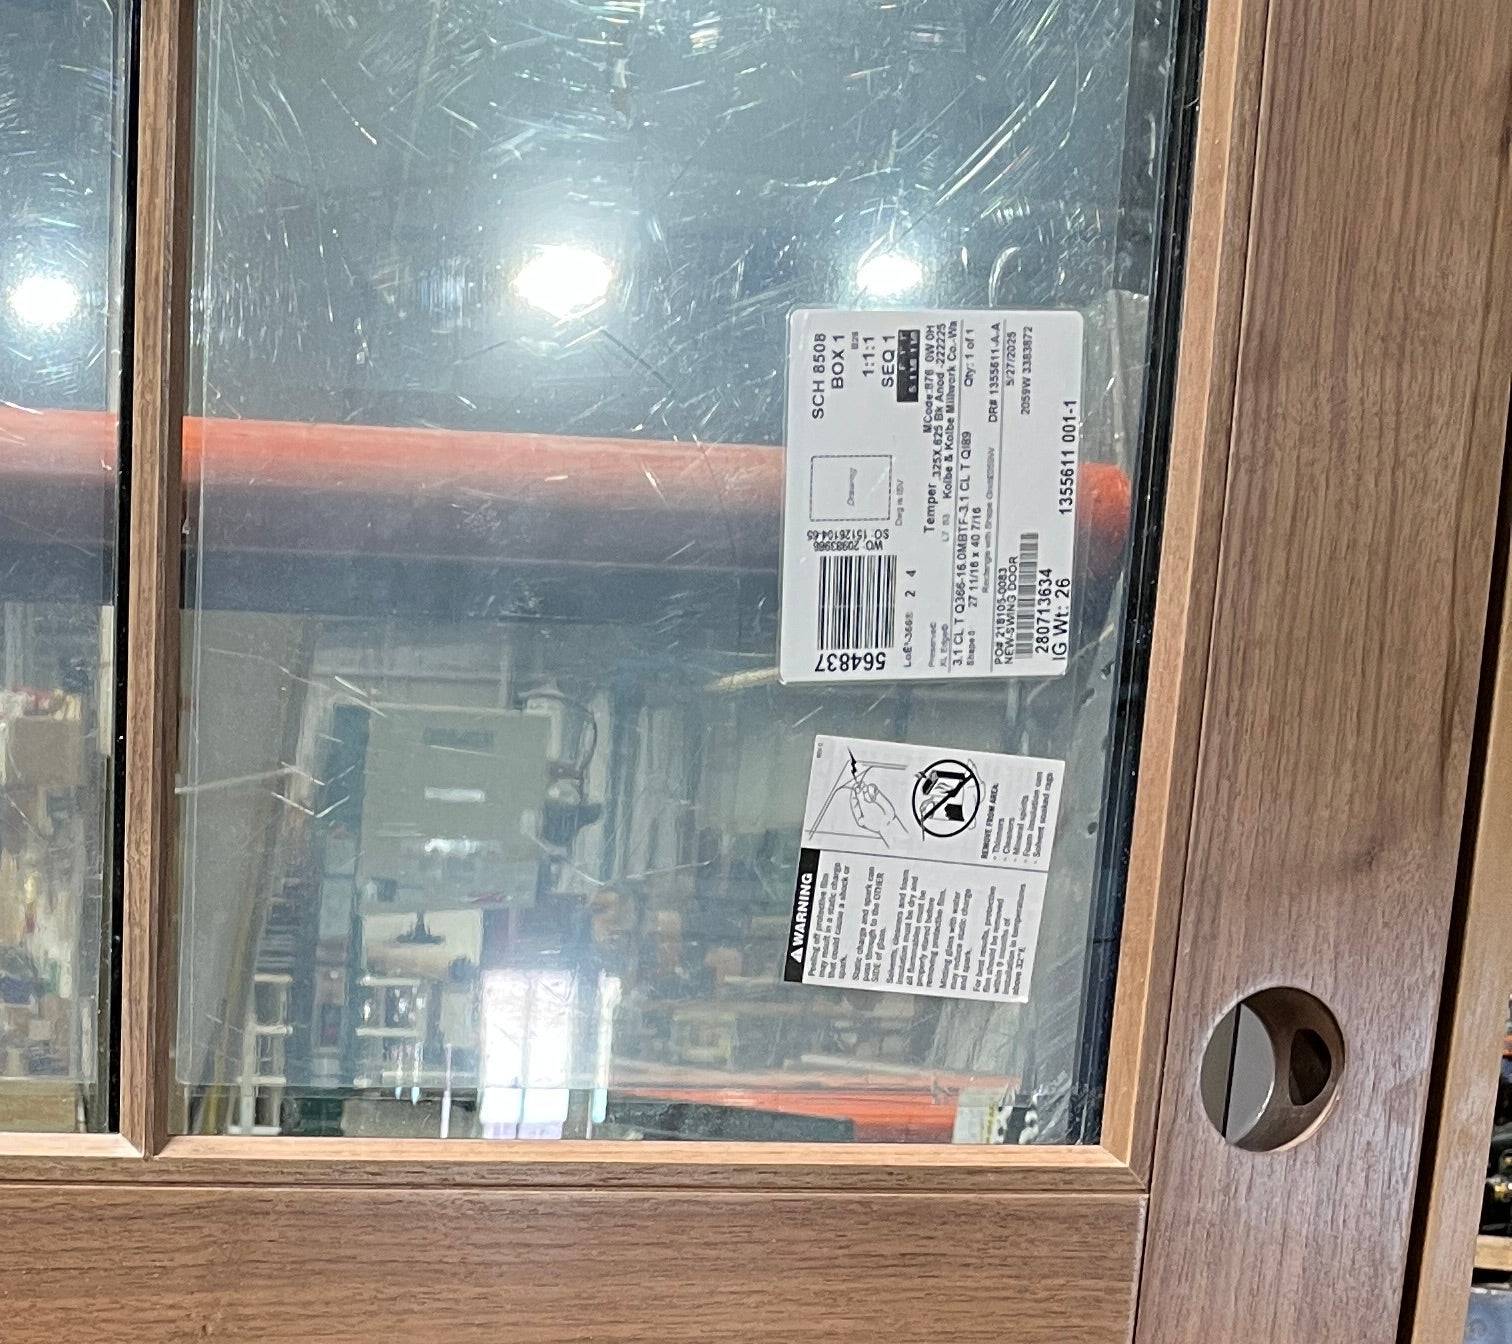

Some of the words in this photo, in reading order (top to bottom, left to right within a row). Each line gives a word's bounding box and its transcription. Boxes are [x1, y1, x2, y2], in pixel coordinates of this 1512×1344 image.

[862, 336, 875, 377] 1:1:1
[965, 338, 974, 349] of
[831, 349, 844, 389] BOX
[881, 350, 895, 387] SEQ
[964, 363, 976, 387] Qty:
[812, 380, 824, 419] SCH
[934, 372, 944, 402] Anod
[947, 365, 956, 414] Millwork
[934, 406, 943, 421] Bk
[988, 400, 997, 423] DR#
[1061, 400, 1077, 443] 001-1
[946, 417, 954, 450] Kolbe
[943, 466, 952, 499] Kolbe
[960, 476, 969, 491] CL
[1058, 449, 1075, 515] 1355611
[923, 483, 938, 533] Temper
[971, 507, 981, 530] 7/16
[971, 534, 980, 547] 40
[969, 561, 979, 591] 11/16
[1008, 556, 1017, 591] DOOR
[1055, 578, 1070, 598] 26
[968, 596, 977, 608] 27
[1036, 569, 1052, 654] 280713634
[1053, 605, 1068, 636] Wt:
[954, 628, 964, 645] CL
[815, 652, 886, 672] 564837
[953, 650, 962, 666] 3.1
[995, 642, 1003, 664] PO#
[1052, 643, 1067, 661] IG
[986, 805, 995, 826] FROM
[792, 873, 812, 946] WARNING
